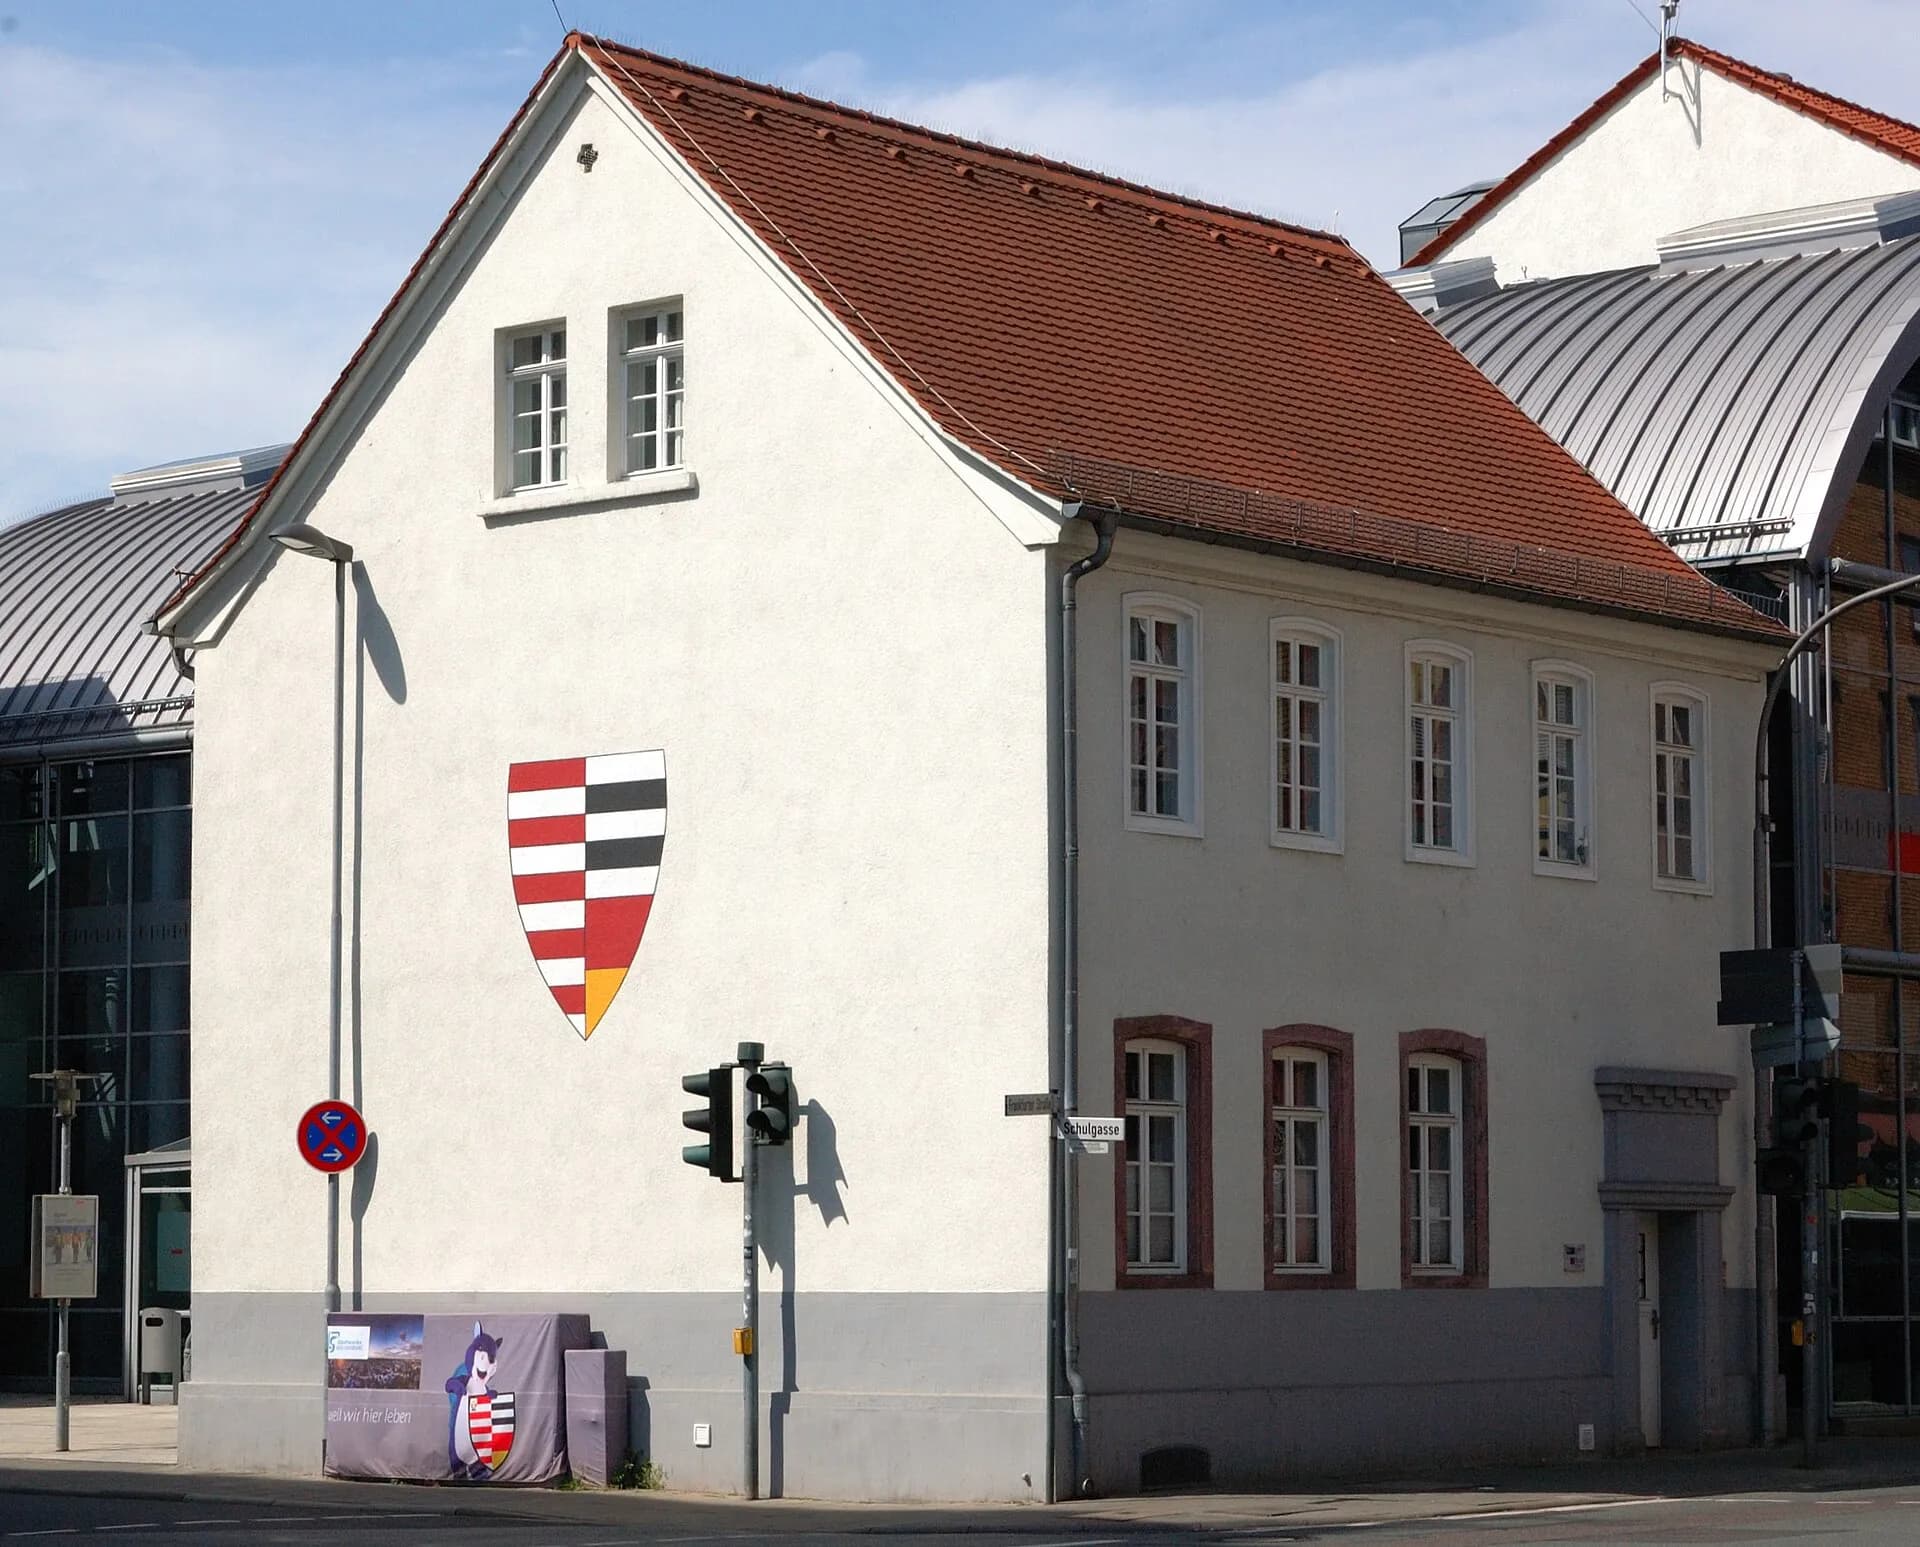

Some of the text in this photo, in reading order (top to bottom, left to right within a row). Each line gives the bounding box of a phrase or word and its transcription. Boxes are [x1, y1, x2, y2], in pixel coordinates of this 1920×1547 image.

[1064, 1122, 1120, 1138] Schulgasse
[343, 1408, 361, 1422] wir
[362, 1407, 383, 1423] hier
[384, 1407, 412, 1424] leben
